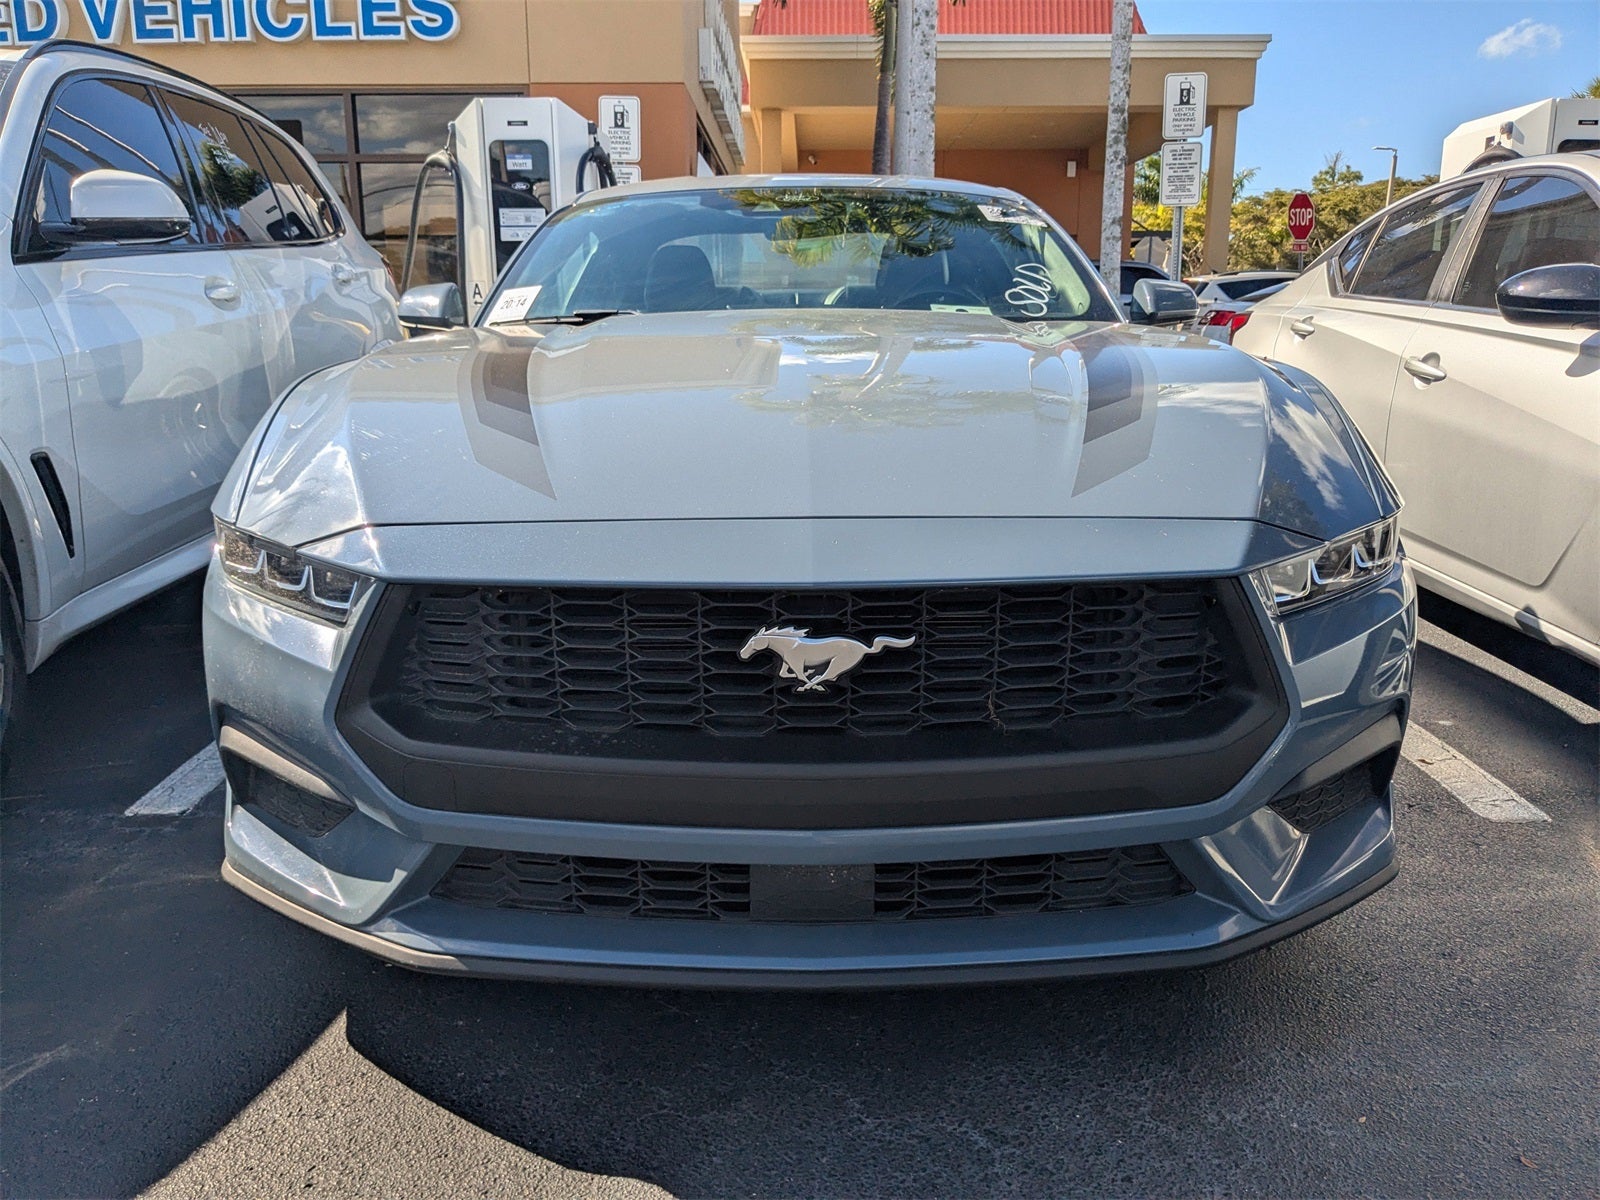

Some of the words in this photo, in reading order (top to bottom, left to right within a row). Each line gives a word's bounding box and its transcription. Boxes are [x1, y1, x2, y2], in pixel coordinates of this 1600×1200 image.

[0, 0, 66, 44] D
[80, 0, 459, 43] VEHICLES
[511, 161, 528, 169] Watt
[1290, 208, 1313, 226] STOP
[473, 283, 483, 299] A
